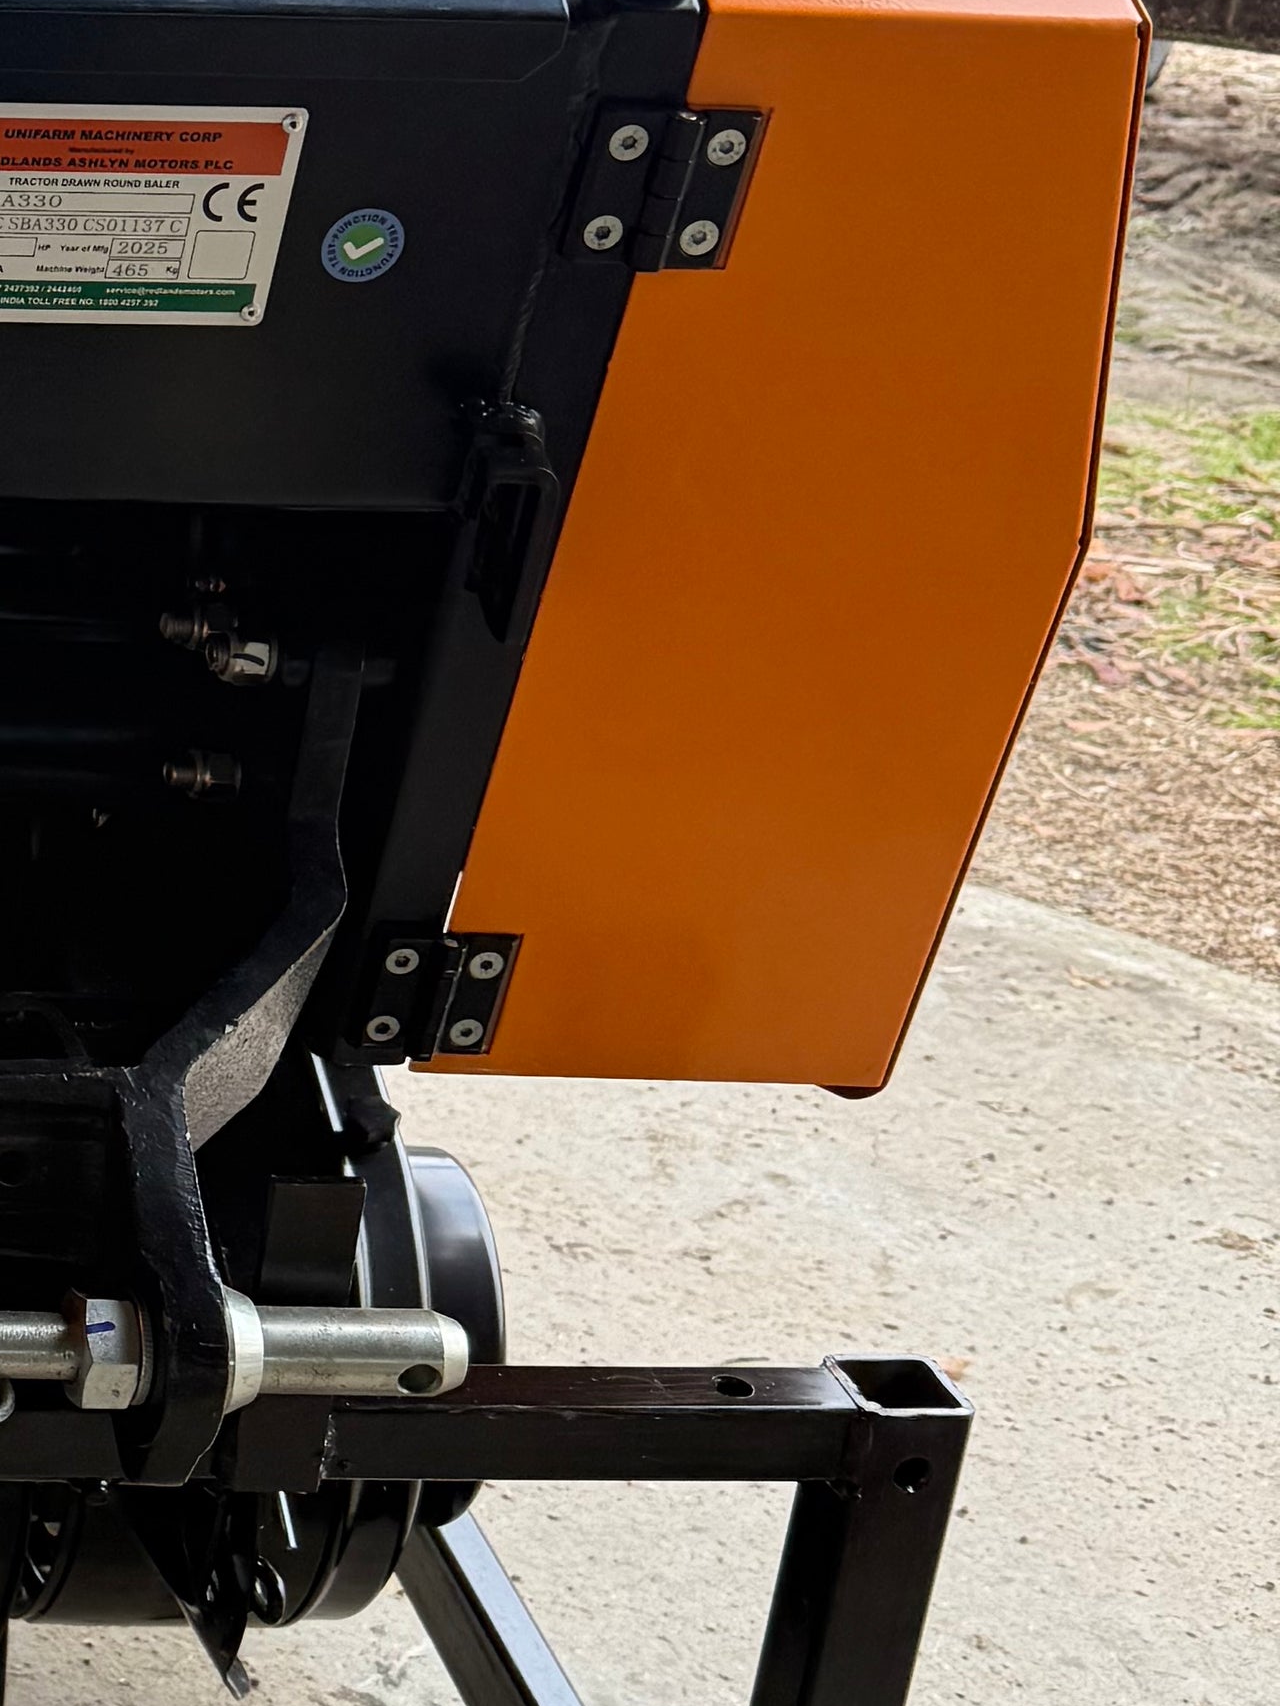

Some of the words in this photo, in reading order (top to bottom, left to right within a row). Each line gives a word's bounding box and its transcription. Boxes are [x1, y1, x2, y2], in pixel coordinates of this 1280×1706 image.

[4, 128, 76, 140] UNIFARM
[79, 129, 175, 142] MACHINERY
[179, 131, 223, 143] CORP
[67, 157, 129, 169] ASHLYN
[133, 158, 199, 170] MOTORS
[204, 160, 234, 170] PLC
[9, 177, 59, 187] TRACTOR
[61, 178, 101, 187] DRAWN
[103, 179, 141, 188] ROUND
[144, 179, 180, 189] BALER
[202, 182, 265, 223] CE
[8, 217, 78, 231] SBA330
[83, 218, 166, 233] CS01137
[169, 220, 183, 233] C
[331, 213, 388, 240] FUNCTION
[60, 244, 80, 252] Year
[117, 241, 169, 255] 2025
[111, 264, 149, 277] 465
[0, 296, 25, 305] INDIA
[27, 297, 51, 305] TOLL
[52, 297, 78, 305] FREE
